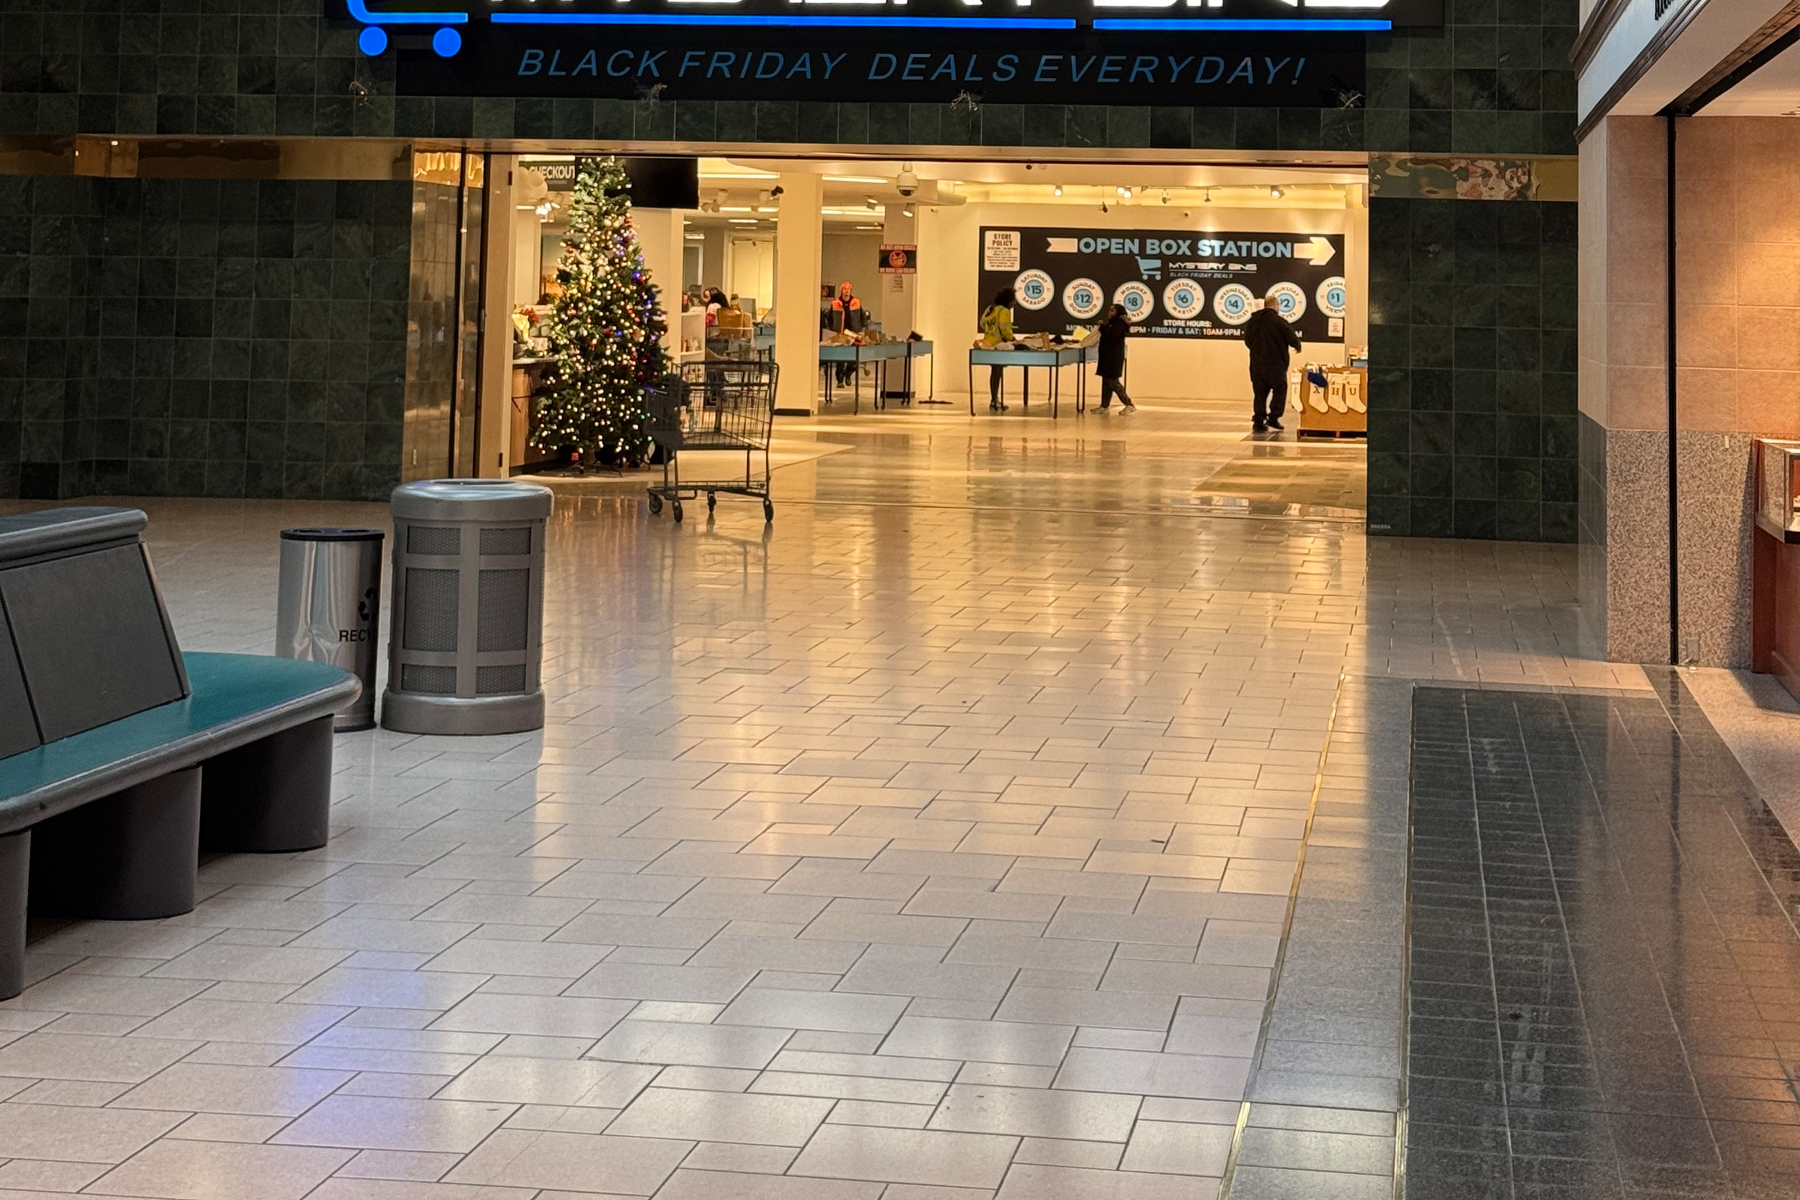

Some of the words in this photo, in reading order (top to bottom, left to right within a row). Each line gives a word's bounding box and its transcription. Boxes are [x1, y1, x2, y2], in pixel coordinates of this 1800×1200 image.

[518, 49, 669, 77] BLACK
[679, 51, 847, 79] FRIDAY
[869, 54, 1020, 82] DEALS
[1033, 56, 1306, 85] EVERYDAY!
[1079, 237, 1140, 255] OPEN
[1146, 239, 1192, 257] BOX
[1197, 239, 1292, 259] STATION
[1168, 261, 1225, 270] MYSTERY
[1021, 273, 1048, 284] SATURDAY
[1026, 285, 1042, 295] $15
[1072, 282, 1096, 291] SUNDAY
[1120, 285, 1148, 296] MONDAY
[1171, 282, 1198, 292] TUESDAY
[1075, 293, 1092, 304] $12
[1178, 293, 1189, 304] $6
[1219, 288, 1251, 301] WEDNESDAY
[1331, 292, 1340, 303] $1
[1127, 297, 1138, 307] $8
[1228, 299, 1239, 309] $4
[1279, 298, 1291, 308] $2
[1163, 319, 1186, 327] STORE
[1186, 320, 1213, 328] HOURS:
[1151, 326, 1177, 334] FRIDAY
